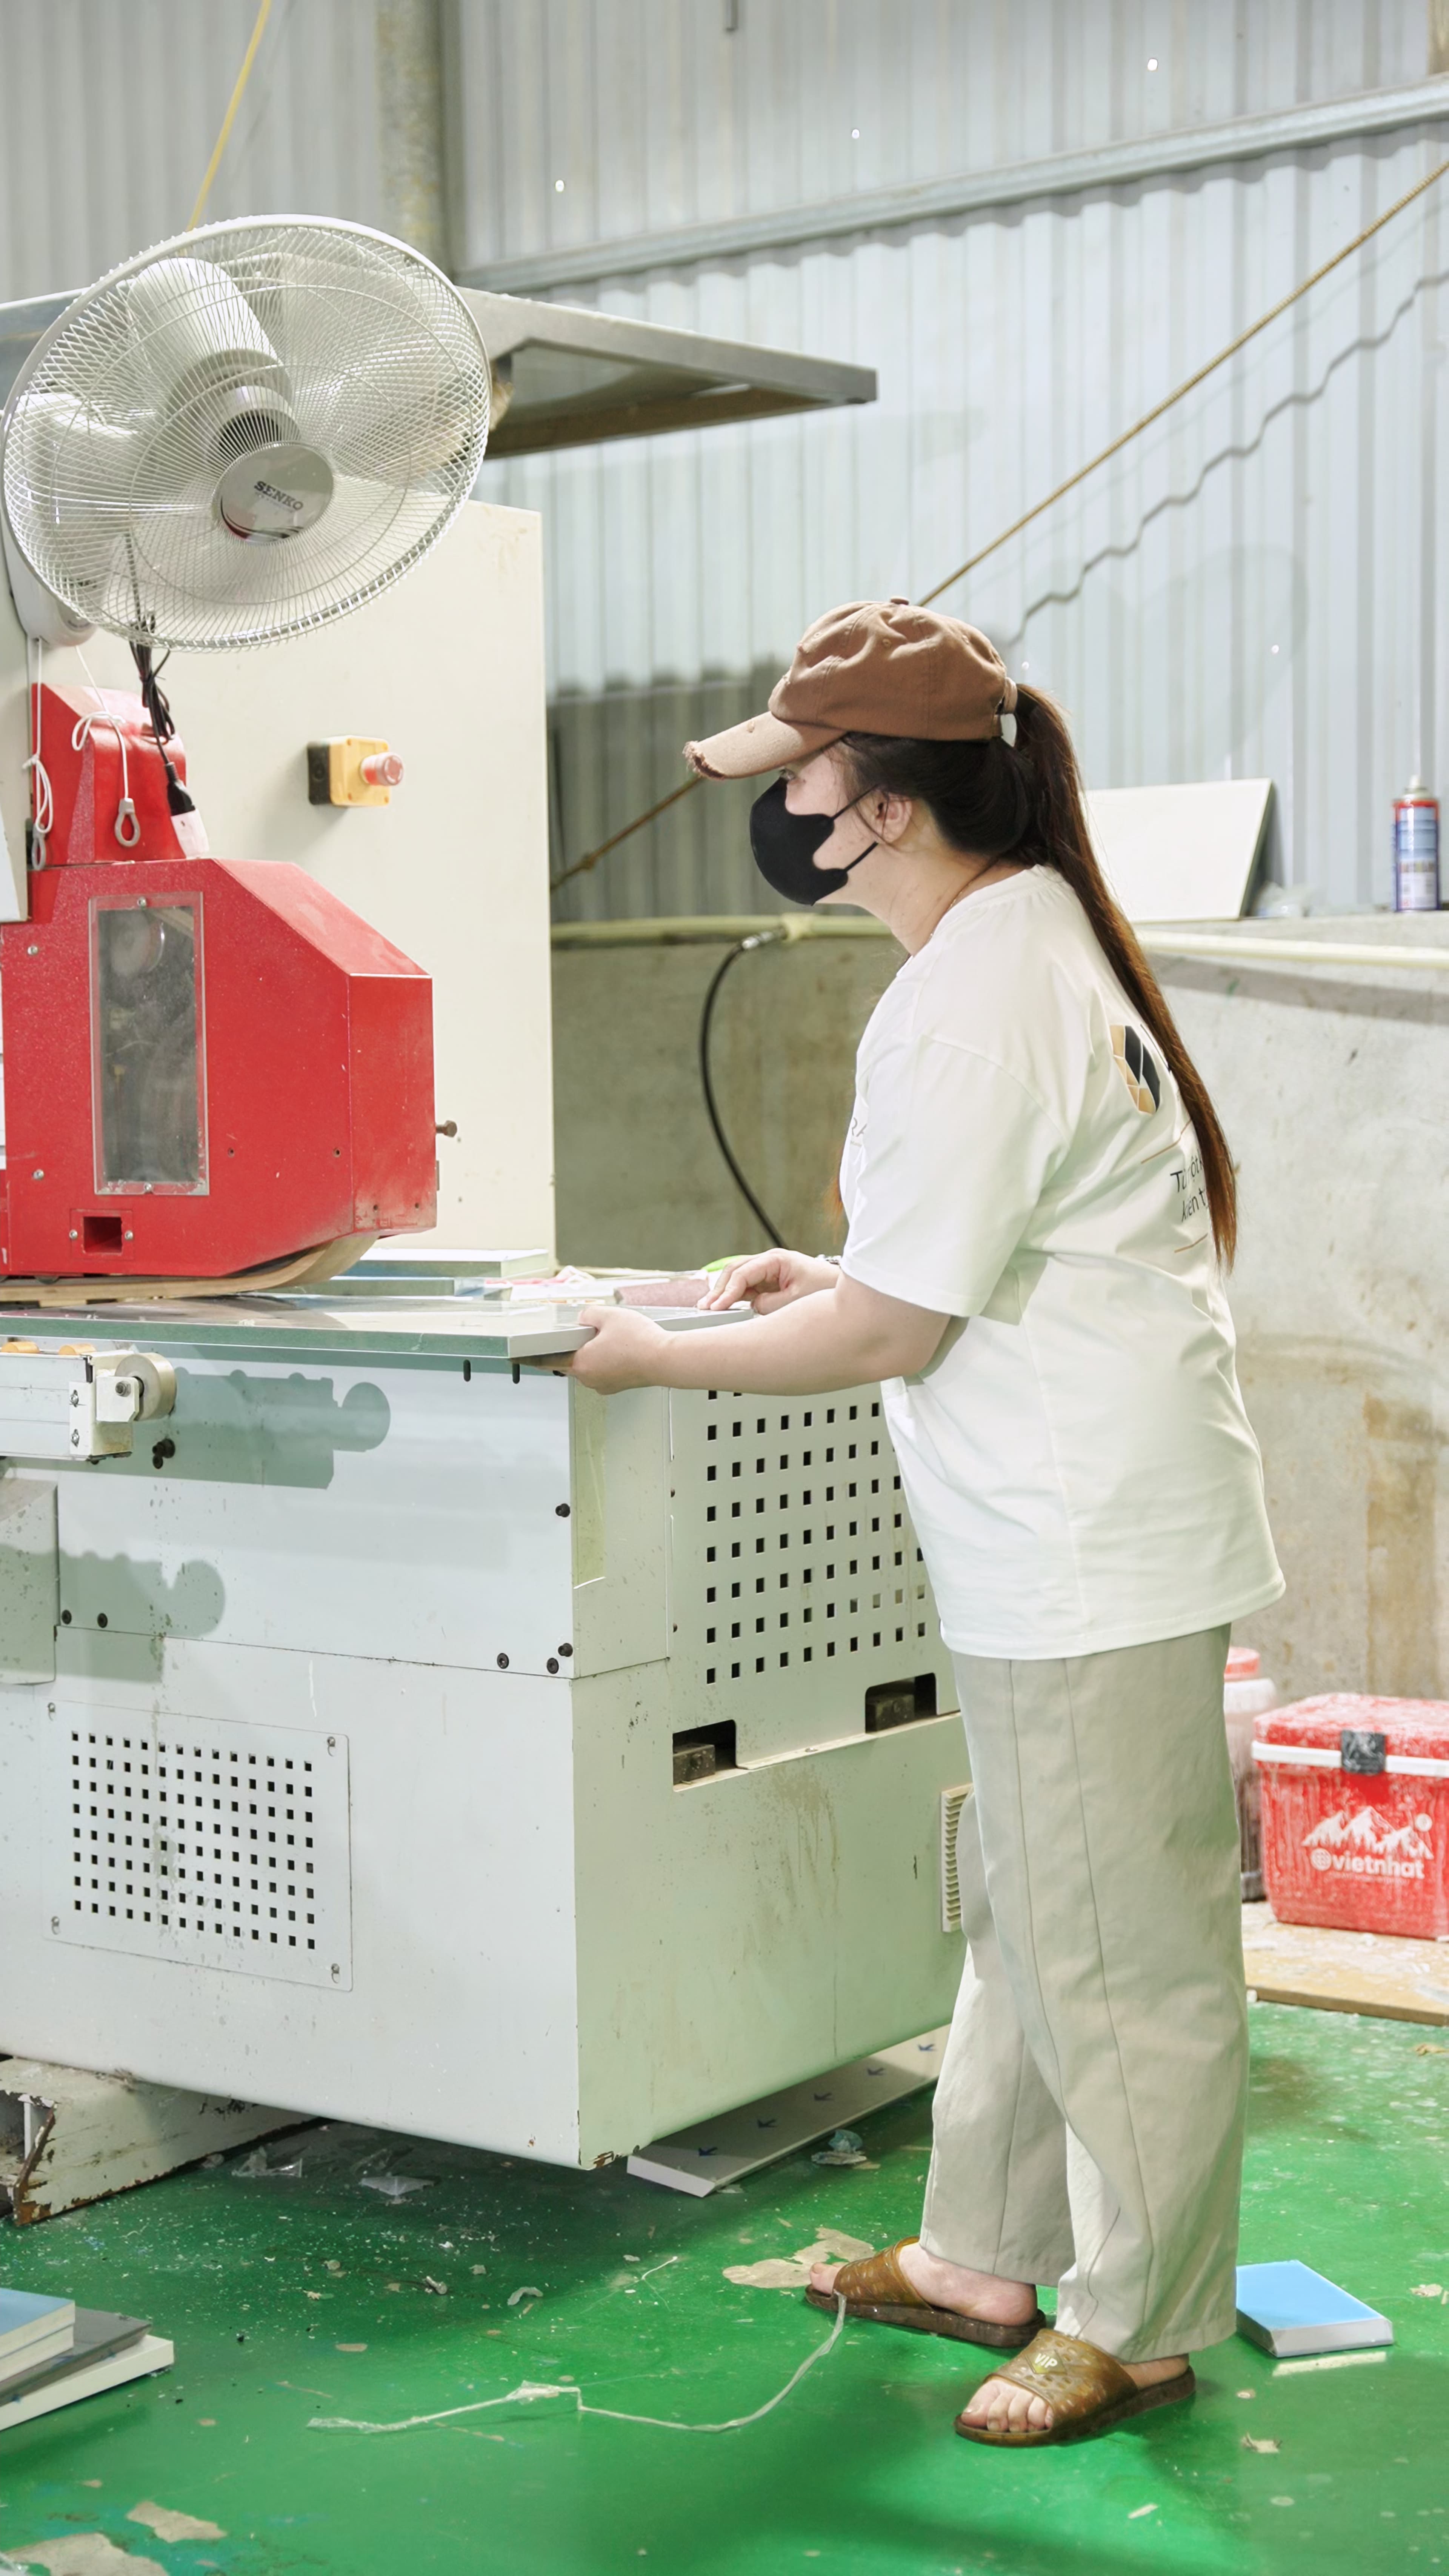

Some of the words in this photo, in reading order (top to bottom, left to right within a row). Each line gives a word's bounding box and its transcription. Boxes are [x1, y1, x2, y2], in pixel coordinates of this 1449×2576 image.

[254, 480, 303, 511] SENKO
[1332, 1850, 1425, 1879] vietnhat
[1035, 2353, 1058, 2368] VIP
